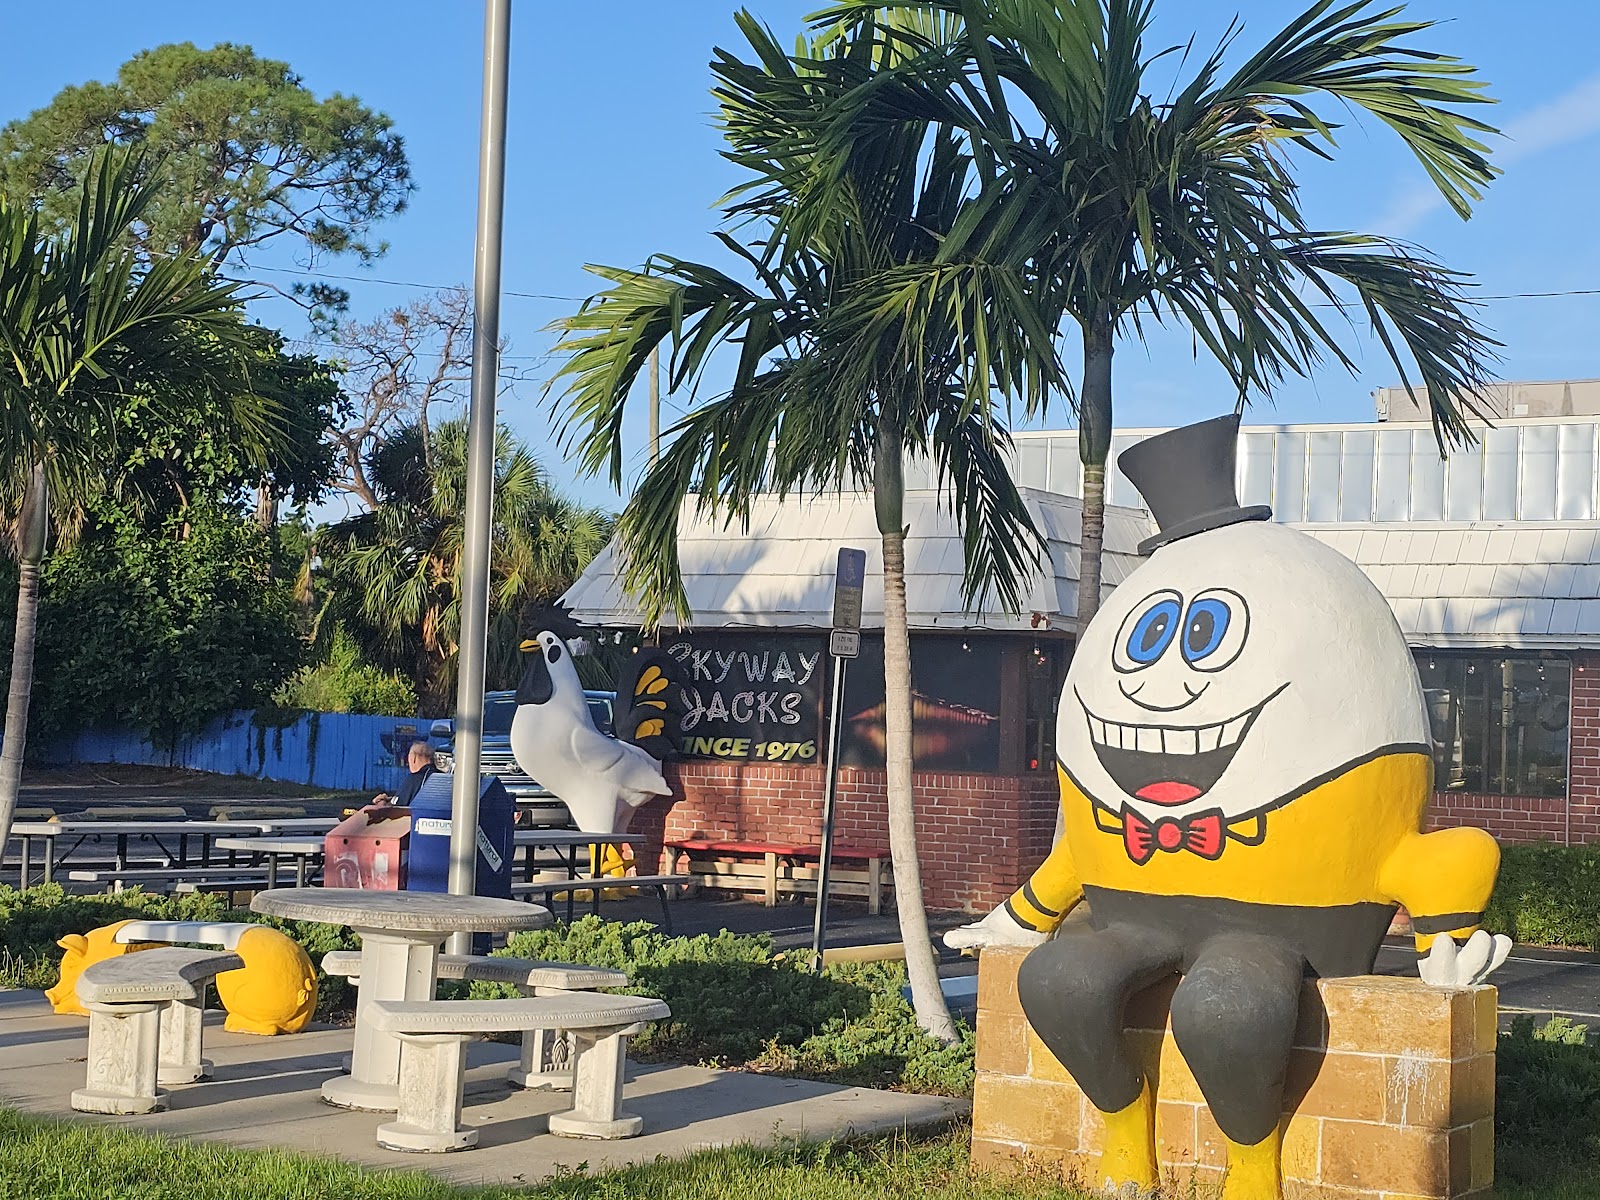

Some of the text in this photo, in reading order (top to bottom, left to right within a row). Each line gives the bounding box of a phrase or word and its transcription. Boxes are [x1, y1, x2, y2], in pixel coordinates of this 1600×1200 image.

[680, 686, 802, 731] JACKS
[682, 736, 816, 761] INCE 1976
[421, 820, 453, 829] natur
[477, 831, 499, 862] natural
